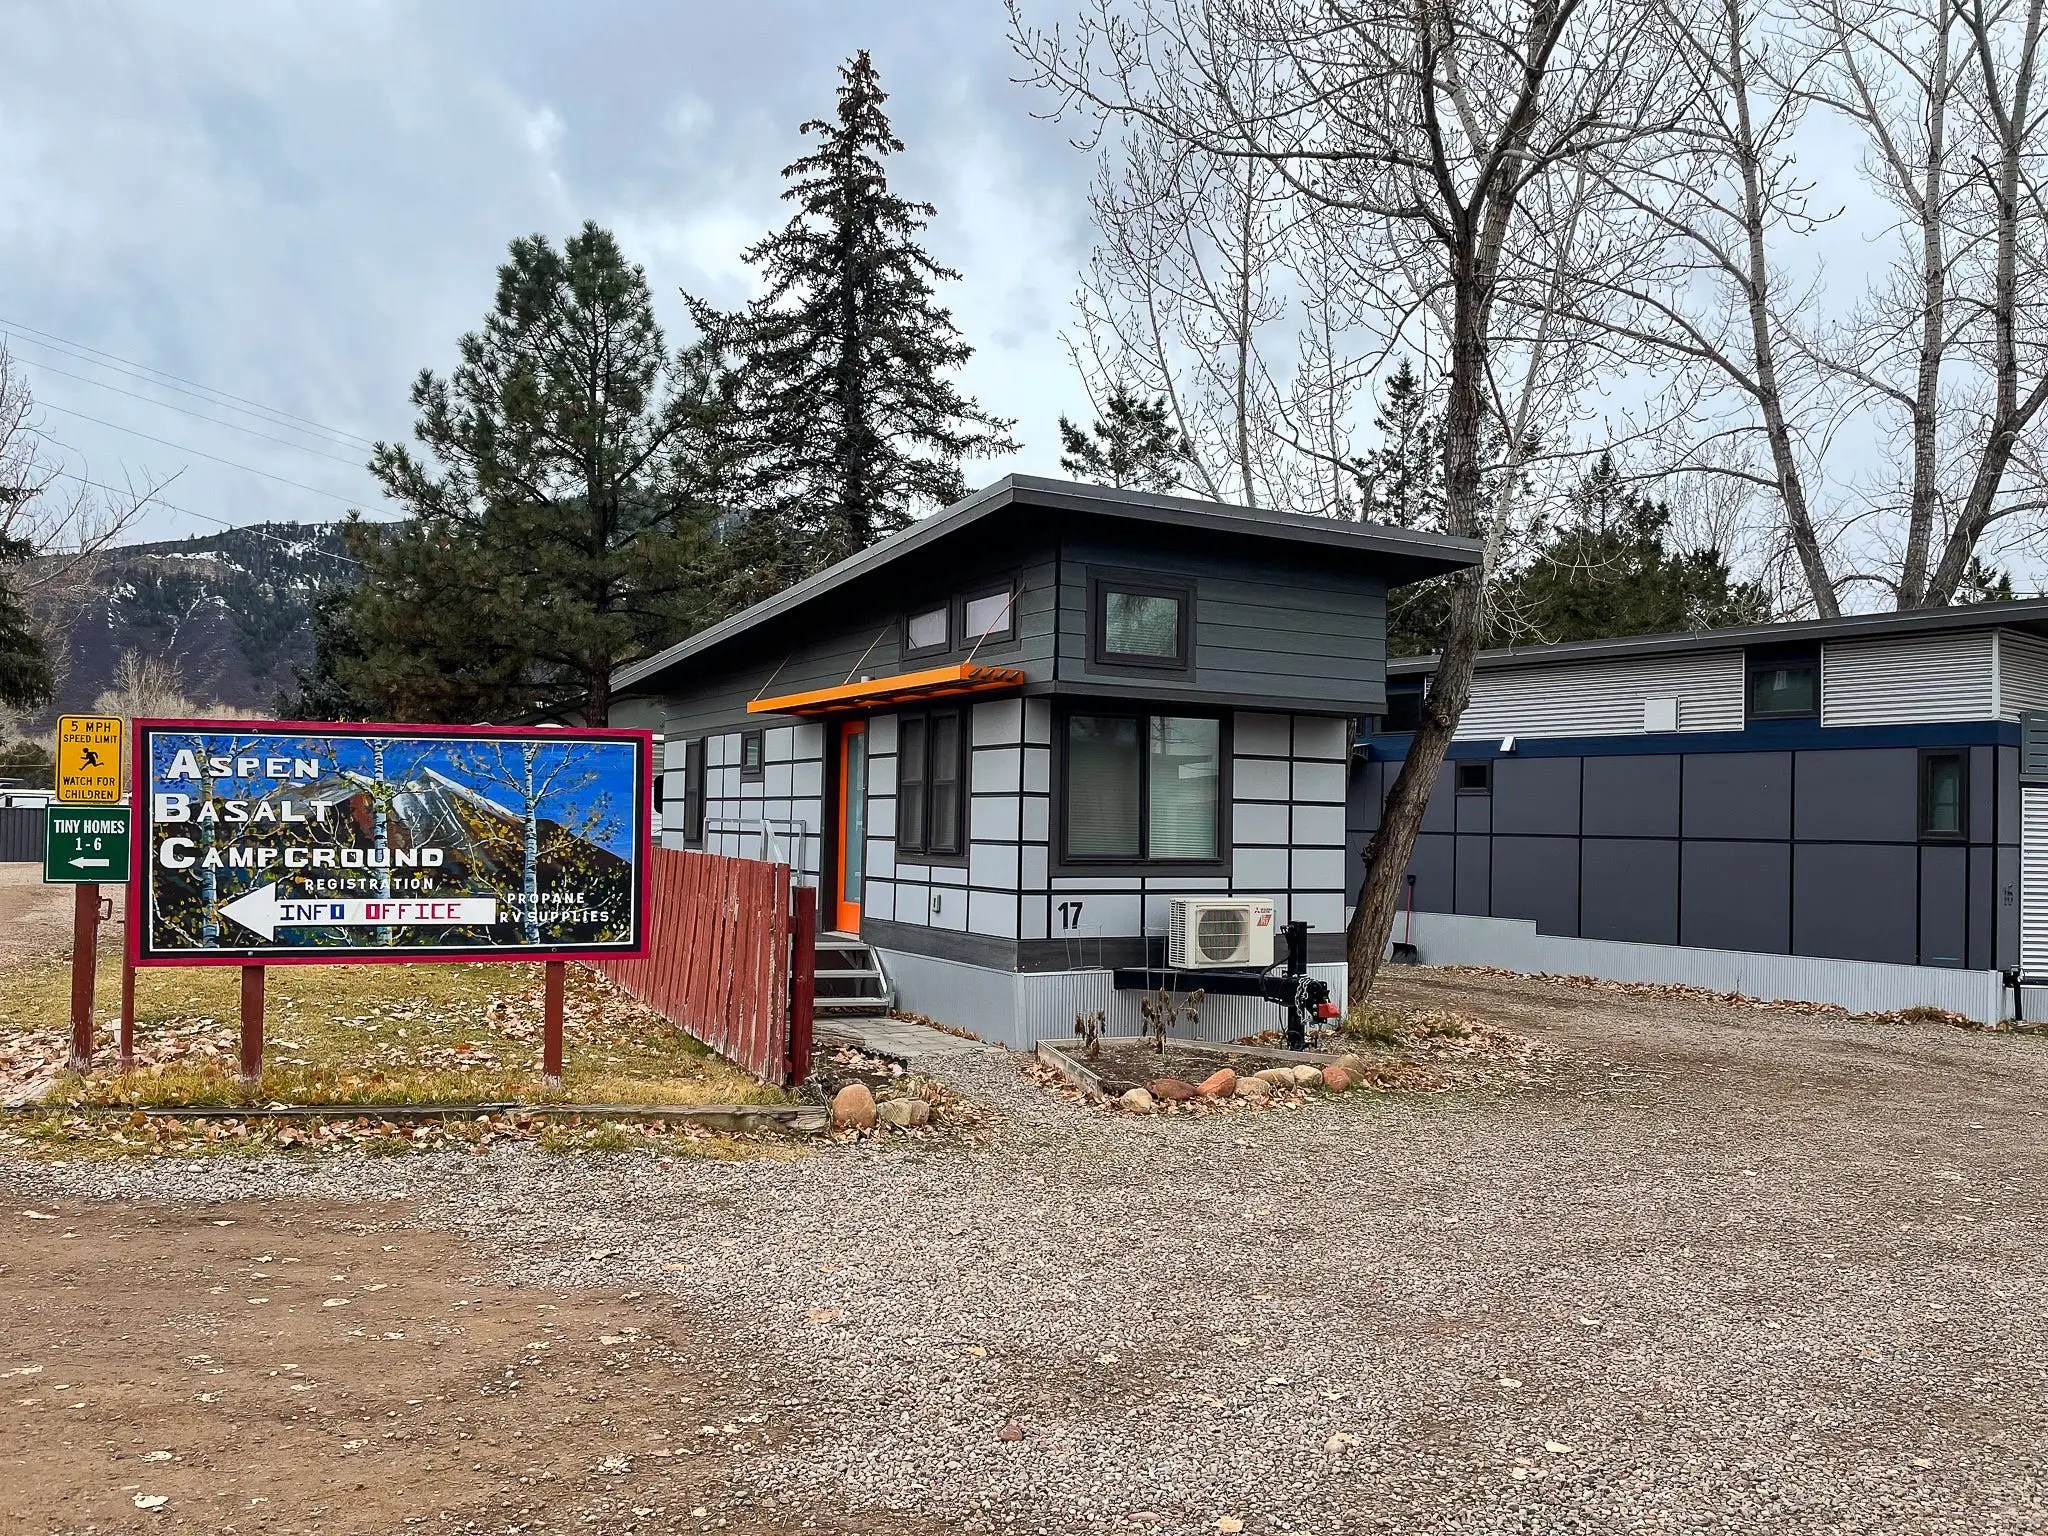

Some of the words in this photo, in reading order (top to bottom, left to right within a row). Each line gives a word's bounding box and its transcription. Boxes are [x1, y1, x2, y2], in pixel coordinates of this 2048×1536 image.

[71, 721, 78, 731] 5
[86, 722, 111, 733] MPH
[63, 734, 91, 743] SPEED
[95, 735, 118, 744] LIMIT
[166, 749, 319, 779] ASPEN
[63, 776, 92, 786] WATCH
[97, 777, 115, 786] FOR
[65, 789, 113, 800] CHILDREN
[154, 793, 333, 823] BASALT
[54, 819, 80, 833] TINY
[84, 820, 125, 834] HOMES
[159, 837, 444, 869] CAMPGROUND
[304, 878, 433, 891] REGISTRATION
[507, 892, 585, 904] PROPANE
[280, 903, 345, 920] INFO
[365, 903, 462, 920] OFFICE
[499, 911, 521, 923] RV
[527, 910, 609, 923] SUPPLIES
[1057, 901, 1083, 930] 17
